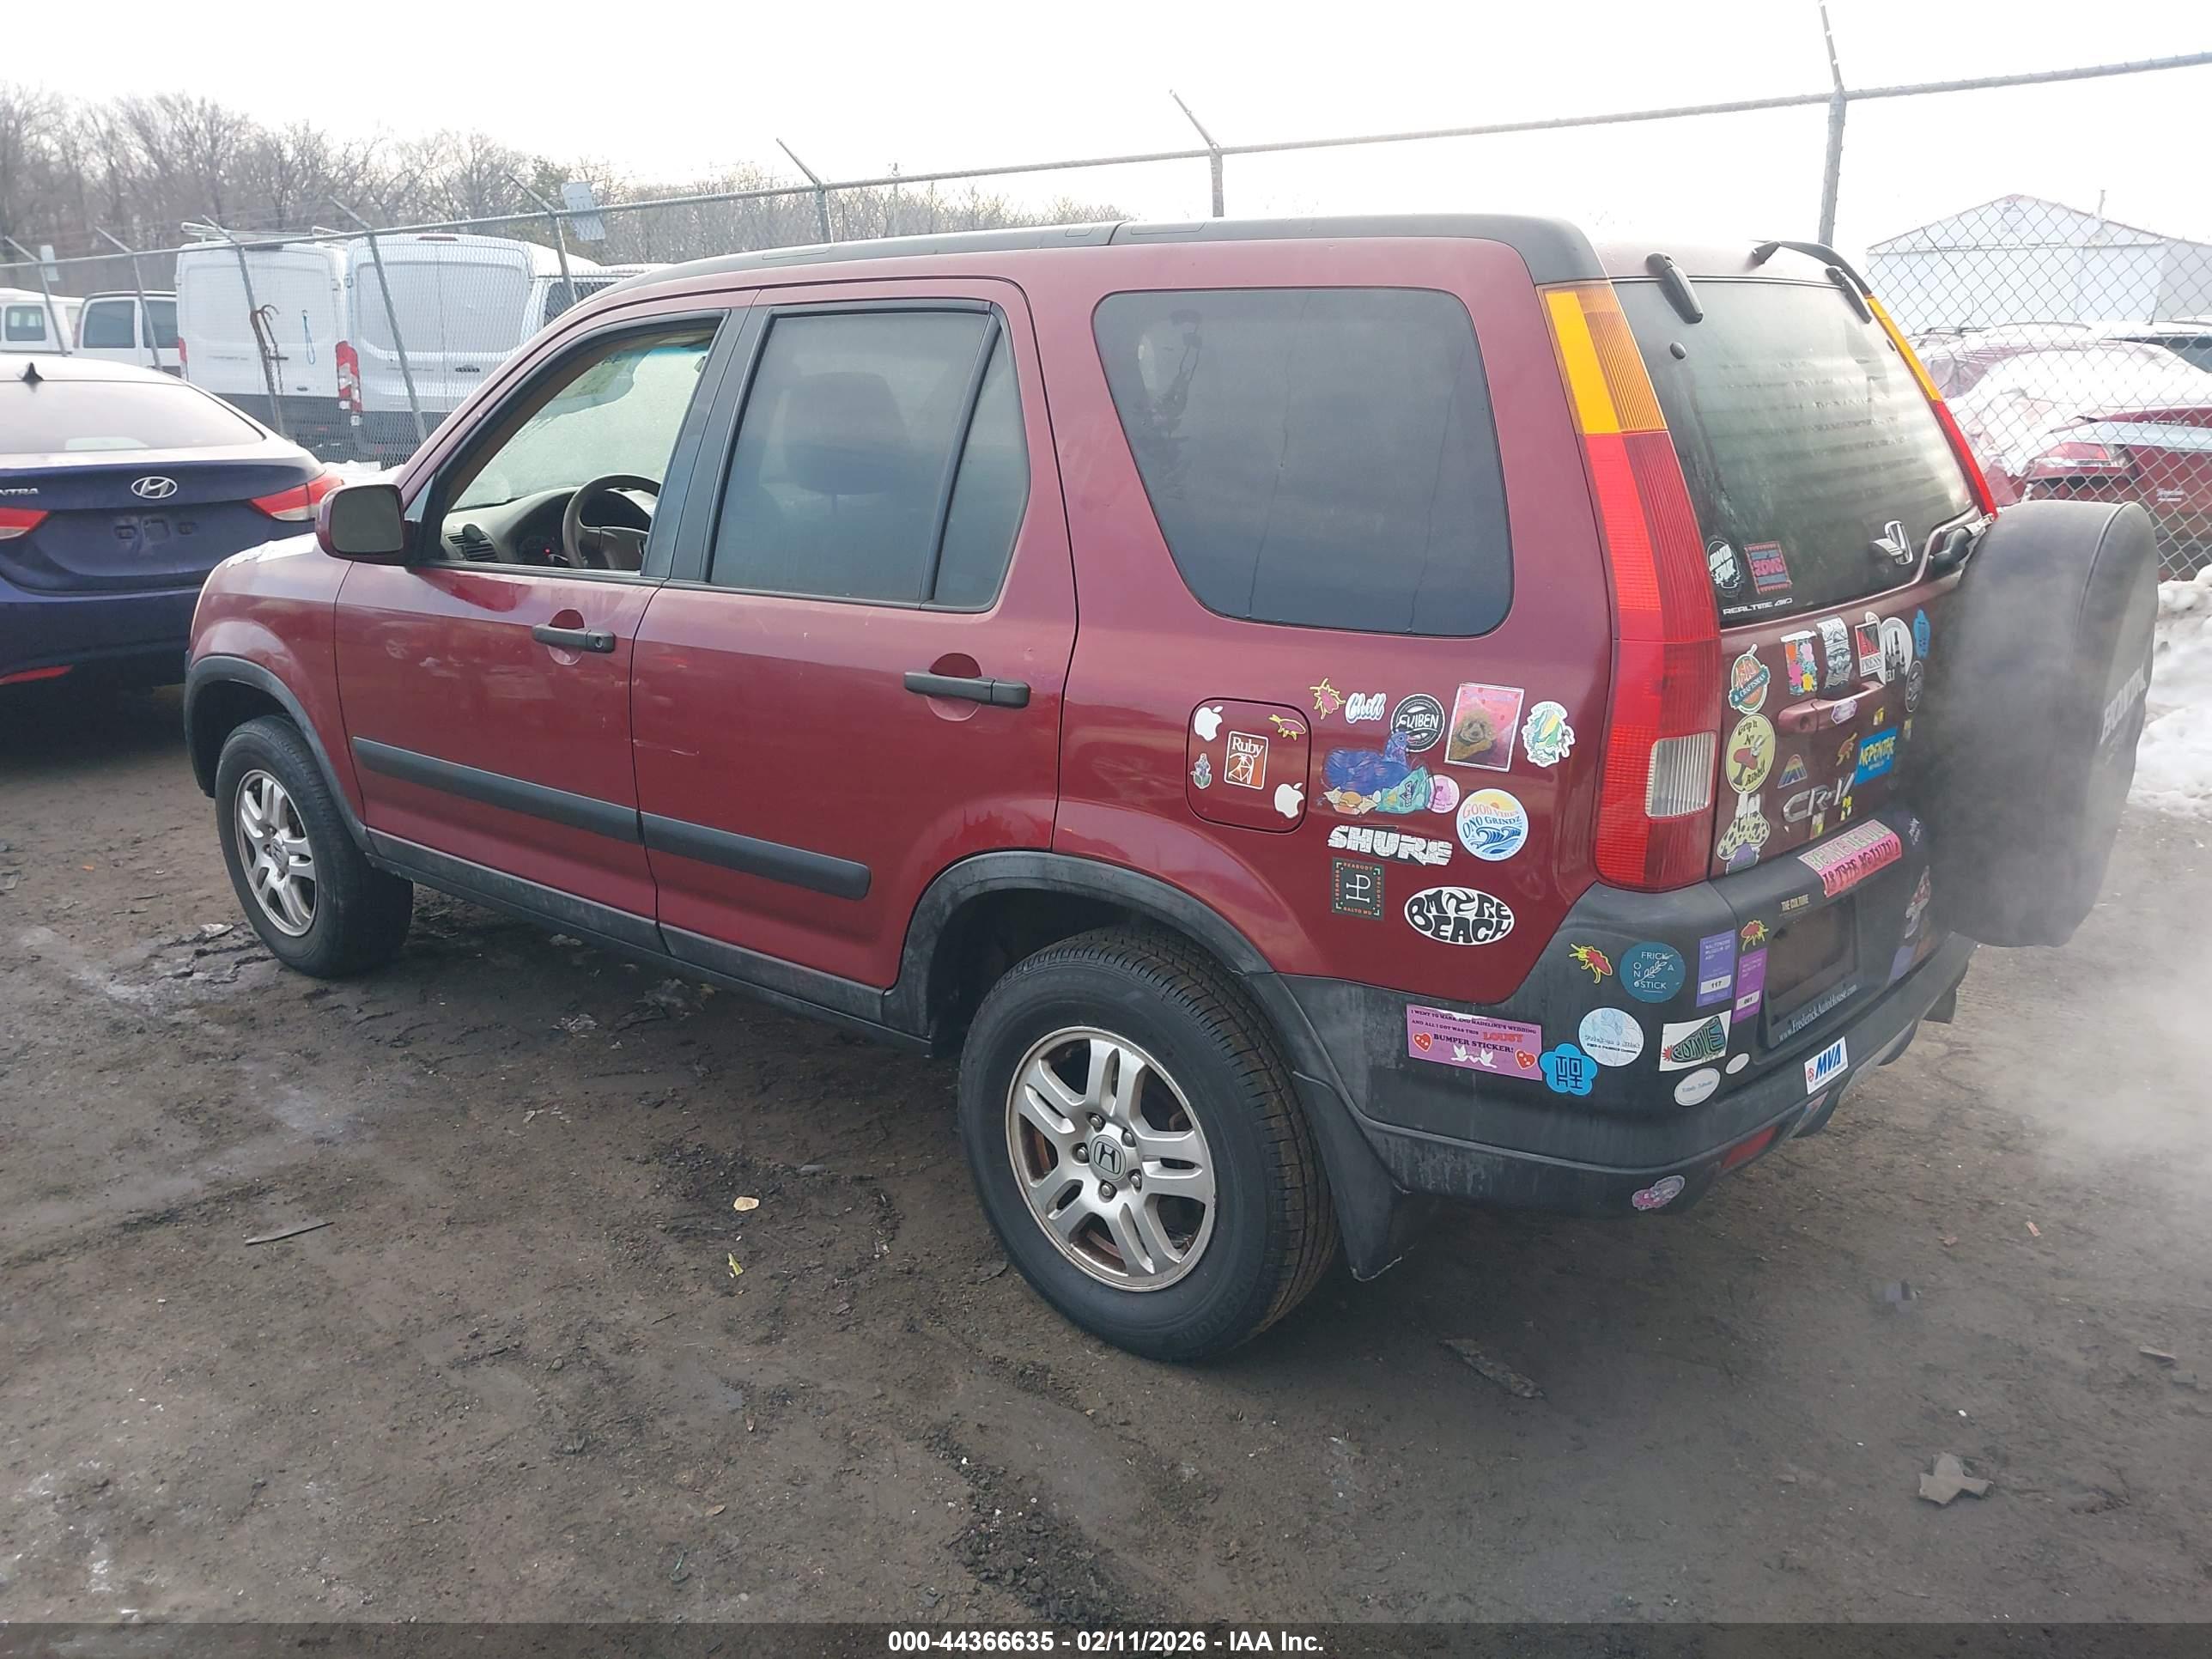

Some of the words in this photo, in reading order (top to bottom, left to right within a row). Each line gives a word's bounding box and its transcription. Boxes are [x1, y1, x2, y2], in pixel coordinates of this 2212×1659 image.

[1723, 601, 1773, 615] REALTIME
[1346, 693, 1387, 723] Chill
[1231, 737, 1264, 757] Ruby
[1463, 804, 1492, 818] GOOD
[1462, 816, 1483, 838] ONO
[1485, 815, 1522, 824] GRINDZ
[1328, 824, 1453, 866] SHURE
[1343, 862, 1372, 871] PEABODY
[1640, 981, 1667, 989] STICK
[1507, 1025, 1537, 1034] WEDDING
[1433, 1033, 1470, 1046] BUMPER
[1472, 1040, 1514, 1053] STICKER!
[1814, 1043, 1842, 1079] MVA
